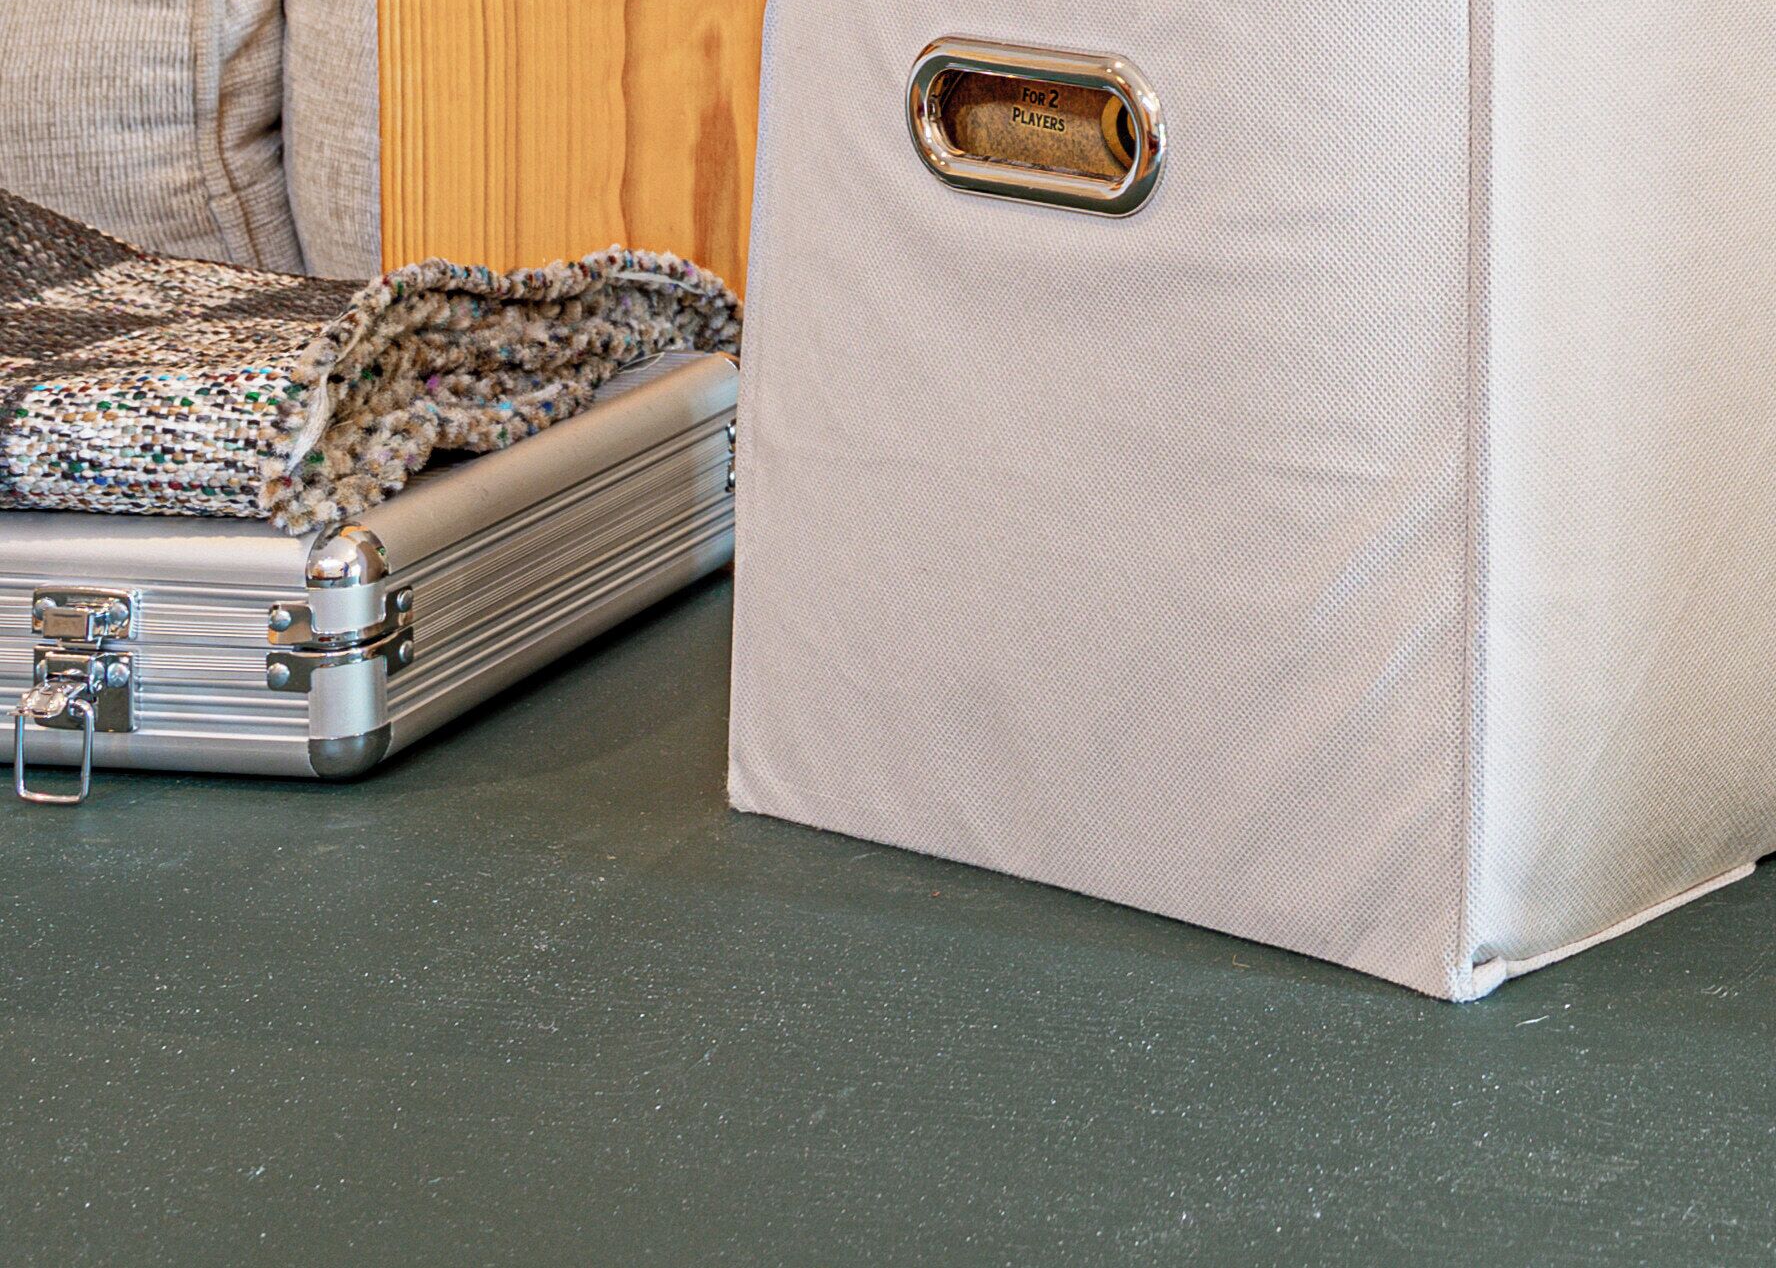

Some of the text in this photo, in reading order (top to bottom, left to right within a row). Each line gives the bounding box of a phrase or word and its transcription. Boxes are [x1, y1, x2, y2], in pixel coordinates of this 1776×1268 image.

[1022, 87, 1059, 109] FOR 2
[1012, 107, 1066, 132] PLAYERS
